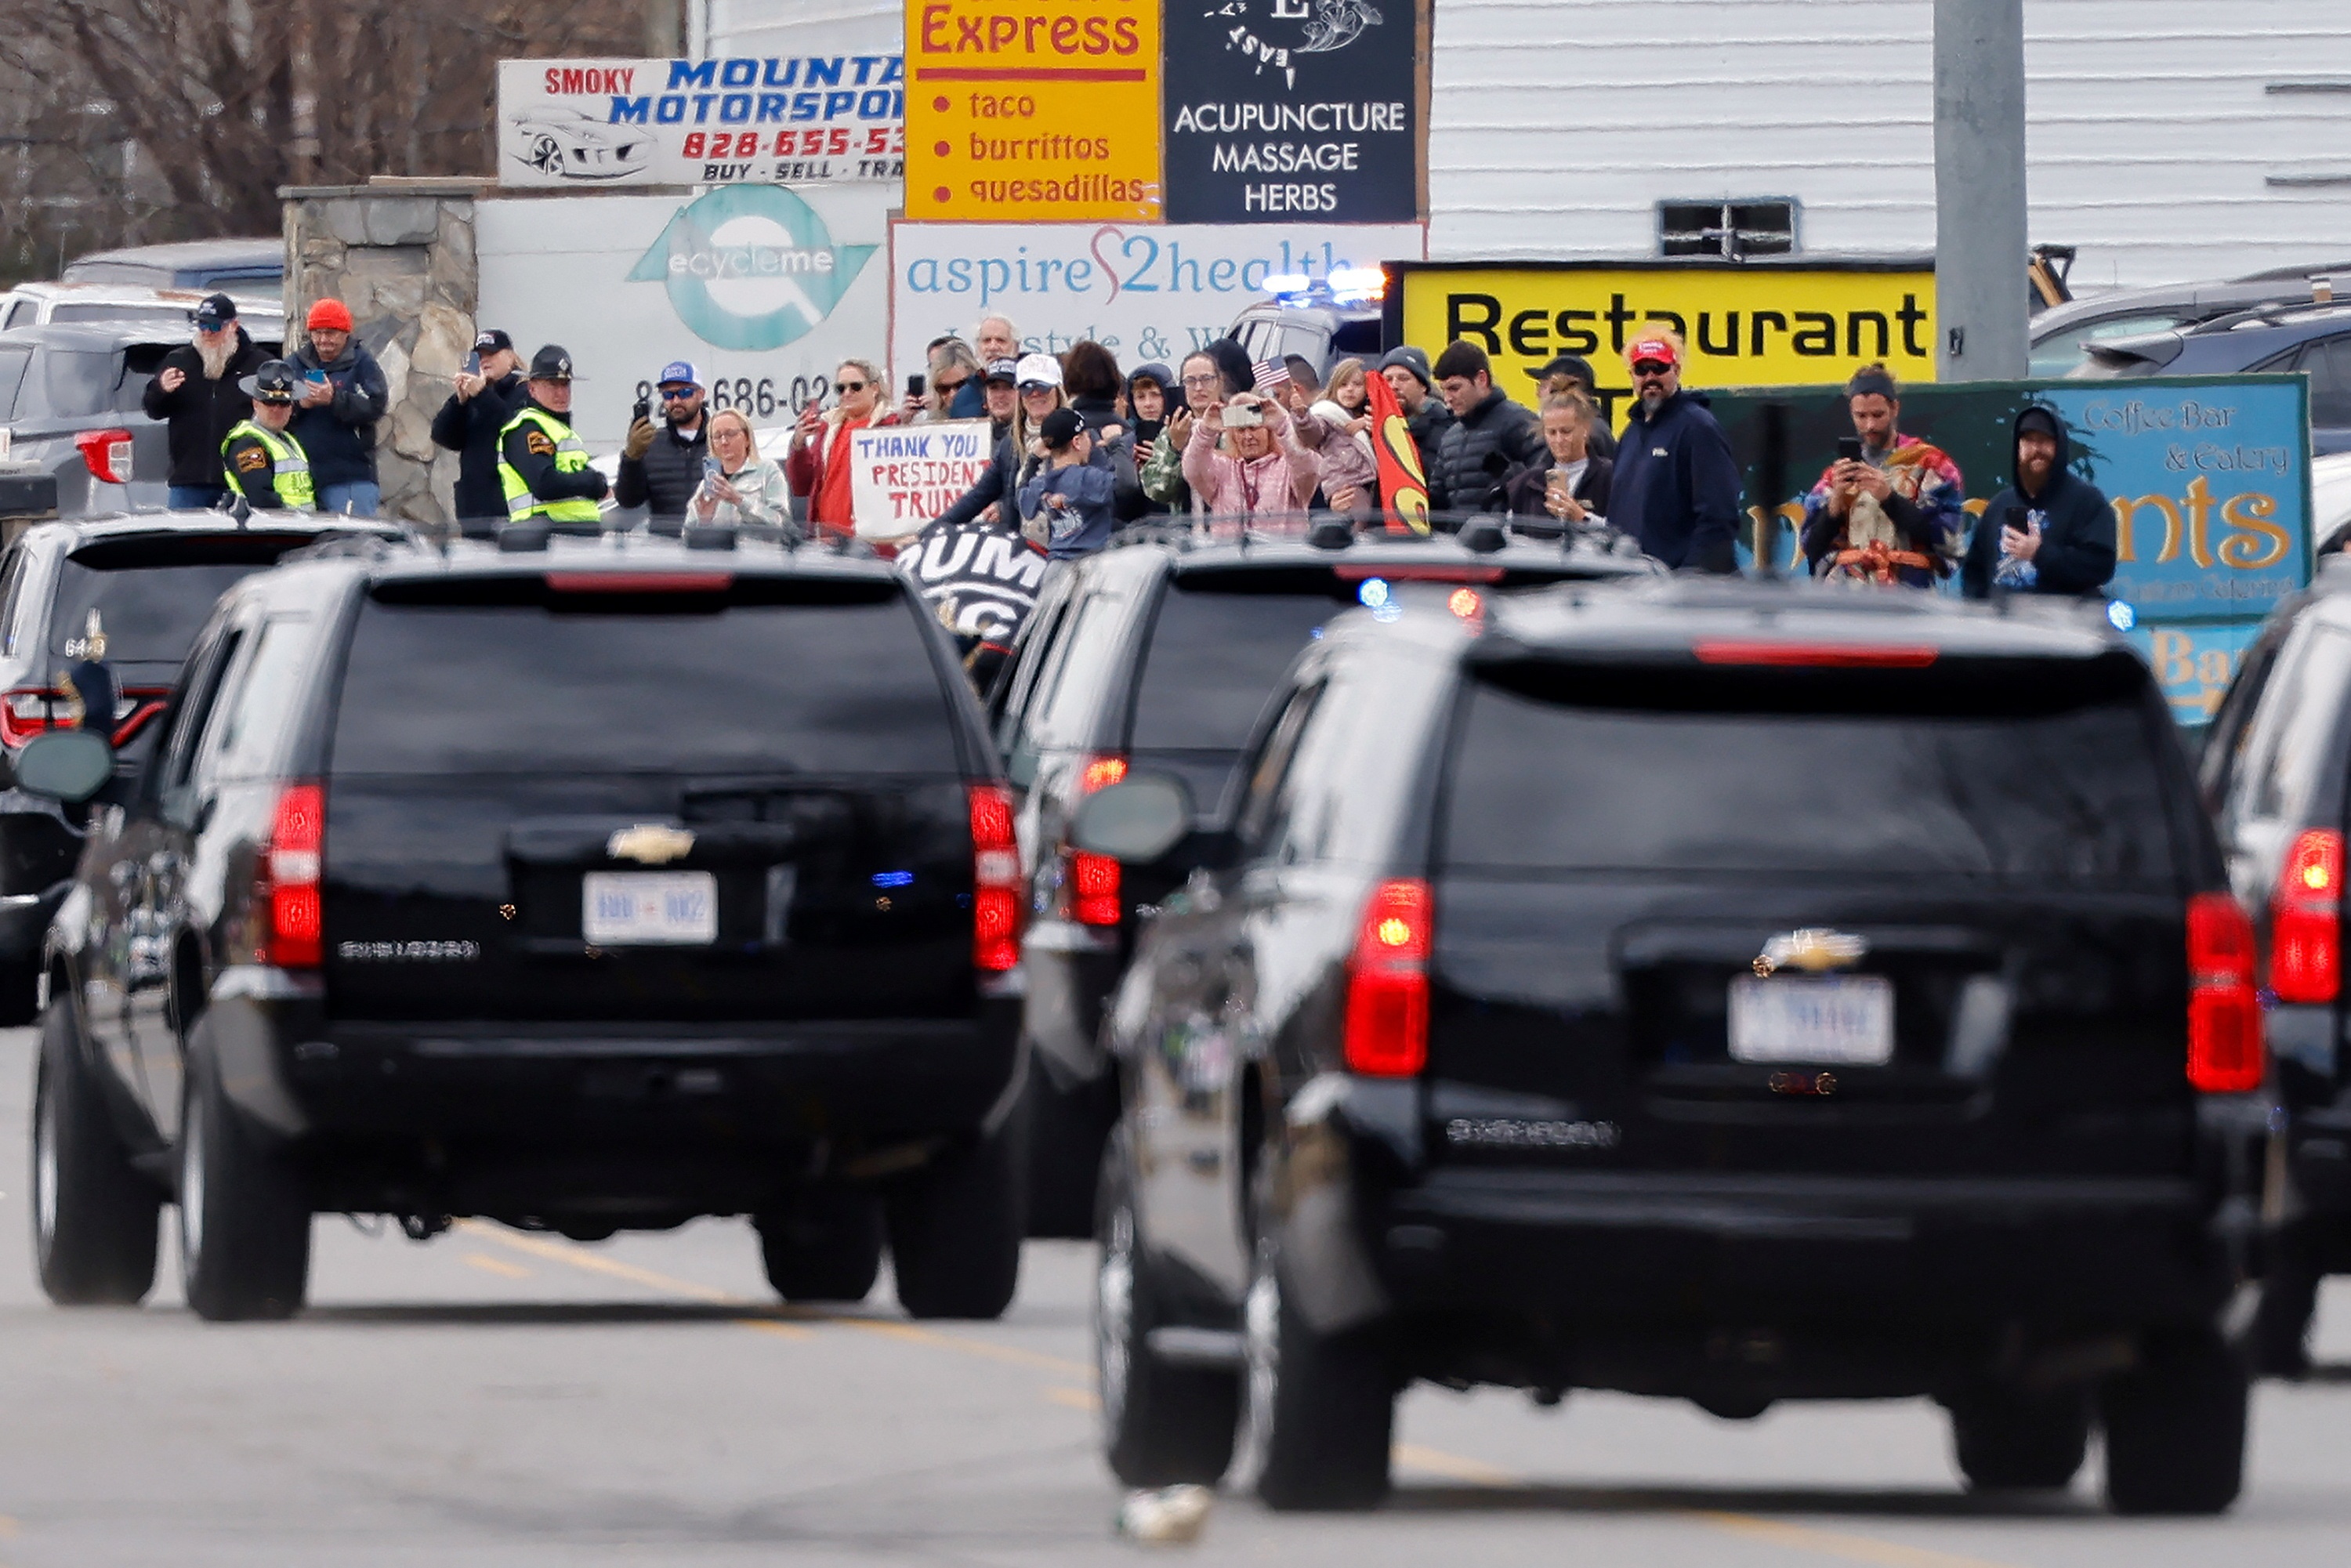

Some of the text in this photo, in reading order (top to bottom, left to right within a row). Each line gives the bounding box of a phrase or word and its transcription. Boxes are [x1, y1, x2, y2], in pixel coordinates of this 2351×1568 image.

[922, 5, 1139, 55] Express
[545, 59, 904, 94] SMOKY MOUNTA
[969, 92, 1034, 118] taco
[1173, 103, 1405, 132] ACUPUNCTURE
[970, 132, 1110, 160] burrittos
[1212, 143, 1359, 172] MASSAGE
[704, 164, 751, 179] BUY
[775, 162, 832, 179] SELL
[970, 174, 1144, 204] quesadillas
[1244, 184, 1337, 212] HERBS
[1138, 326, 1171, 360] &
[2085, 400, 2235, 436] Coffee Bar
[857, 433, 978, 458] THANK YOU
